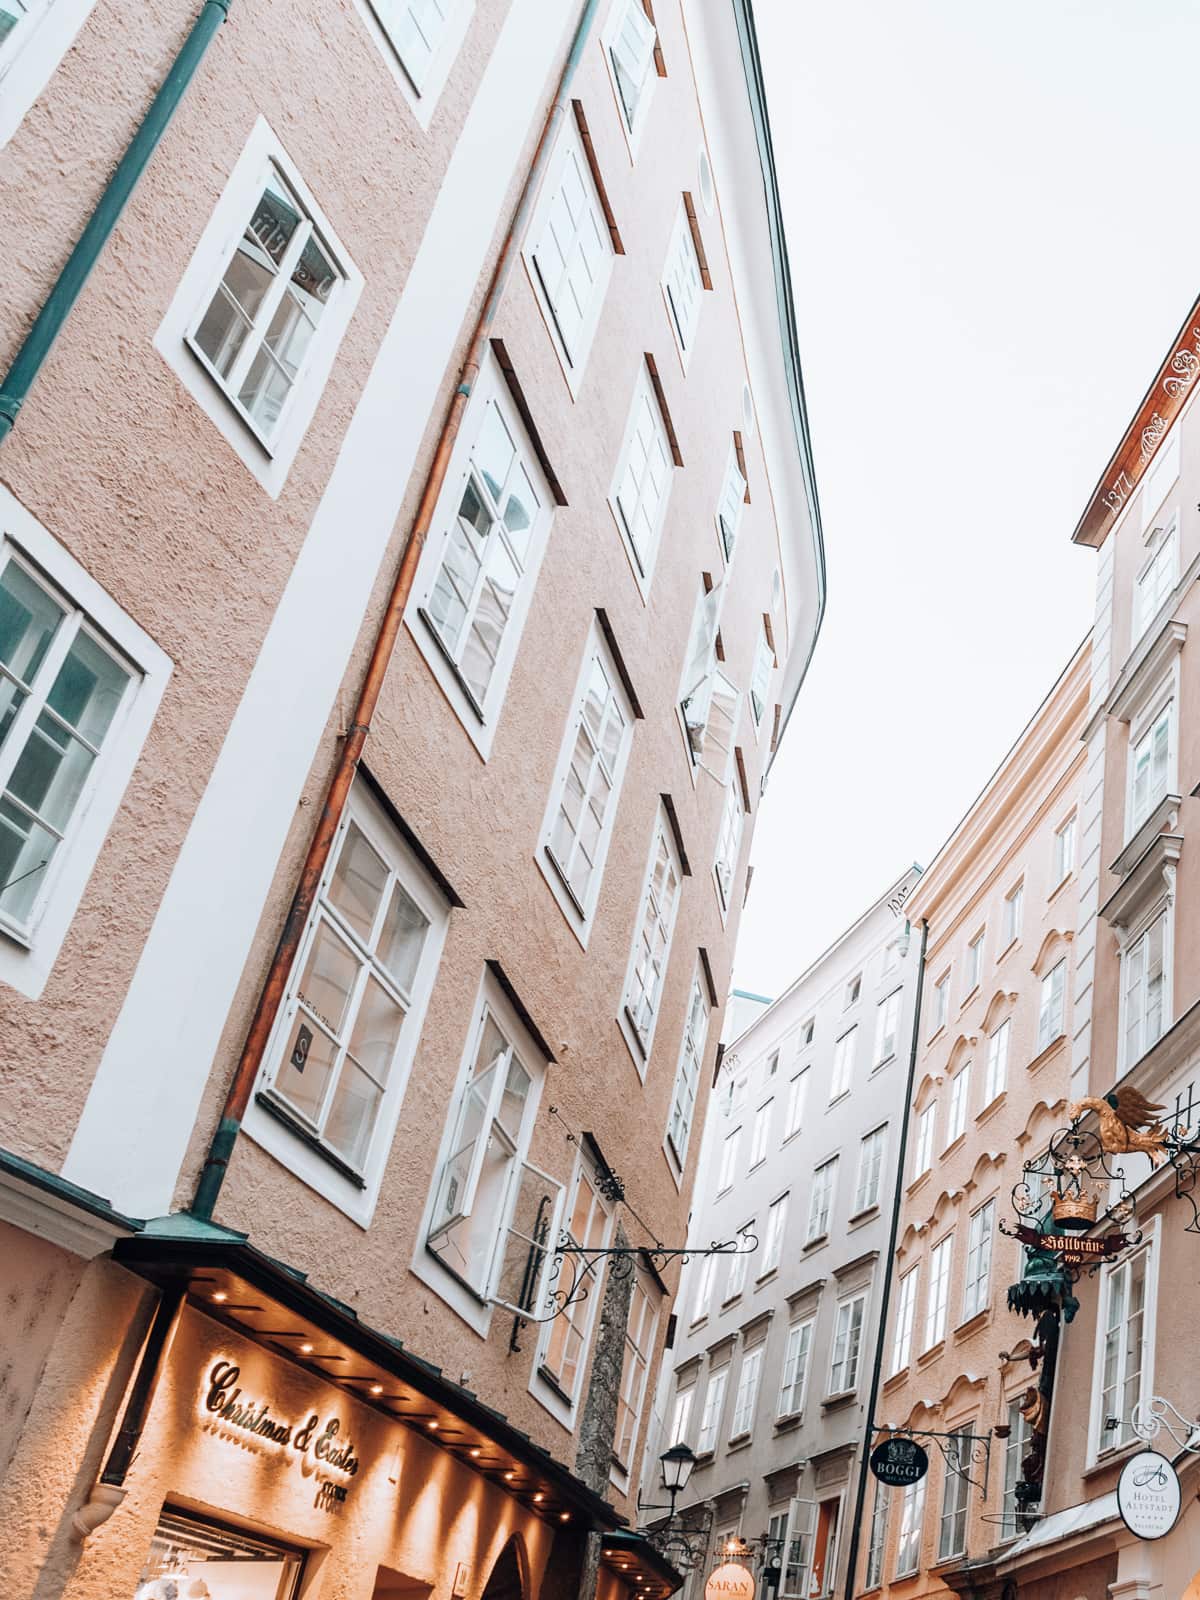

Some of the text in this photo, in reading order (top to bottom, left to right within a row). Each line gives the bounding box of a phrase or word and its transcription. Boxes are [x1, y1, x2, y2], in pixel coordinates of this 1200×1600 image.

[1102, 471, 1134, 514] 1377
[1045, 1235, 1100, 1253] Höllbräu
[206, 1361, 359, 1476] Christmas & Easter
[877, 1462, 920, 1478] BOGGI
[1126, 1501, 1175, 1513] ALTSTADT
[708, 1580, 750, 1592] SARAN
